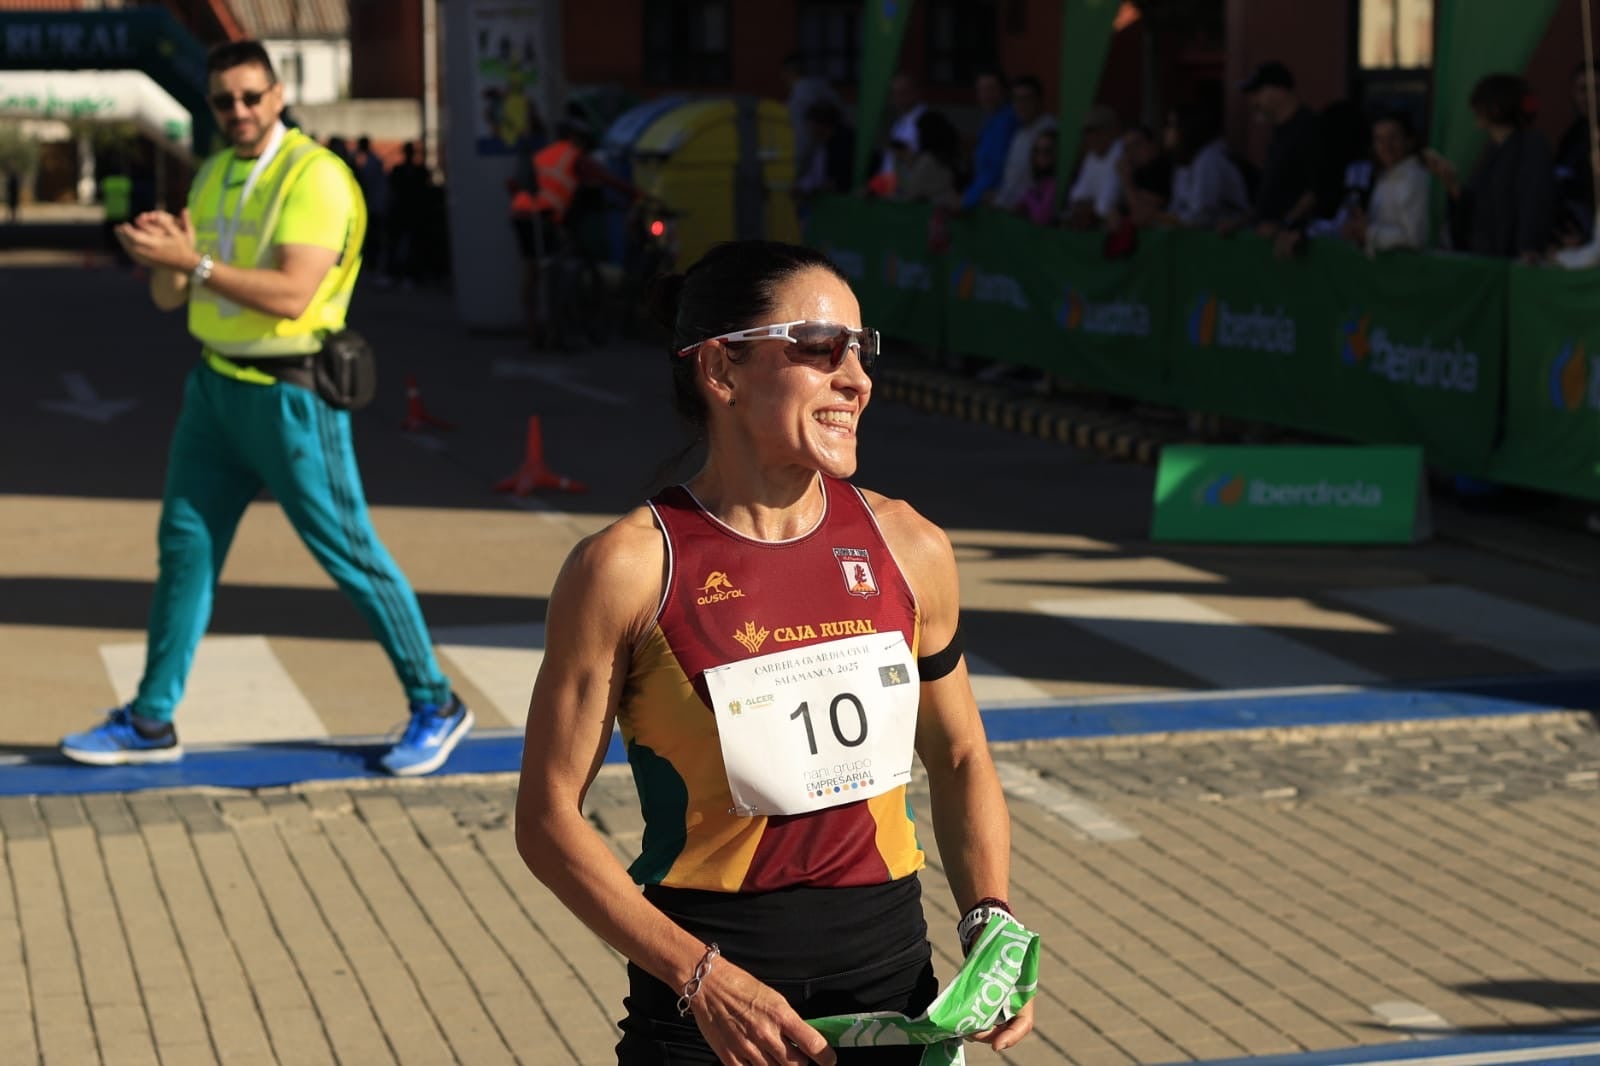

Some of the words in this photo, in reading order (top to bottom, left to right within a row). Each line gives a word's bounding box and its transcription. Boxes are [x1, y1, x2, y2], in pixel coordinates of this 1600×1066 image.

[6, 22, 136, 55] RURAL
[697, 588, 746, 606] austral
[773, 624, 818, 642] CAJA
[819, 619, 878, 638] RURAL
[753, 658, 801, 677] CARRERA
[846, 644, 870, 658] CIVIL
[774, 666, 835, 687] SALAMANCA
[837, 662, 859, 676] 2025
[789, 692, 869, 755] 10
[833, 758, 872, 775] grupo
[806, 770, 873, 792] EMPRESARIAL
